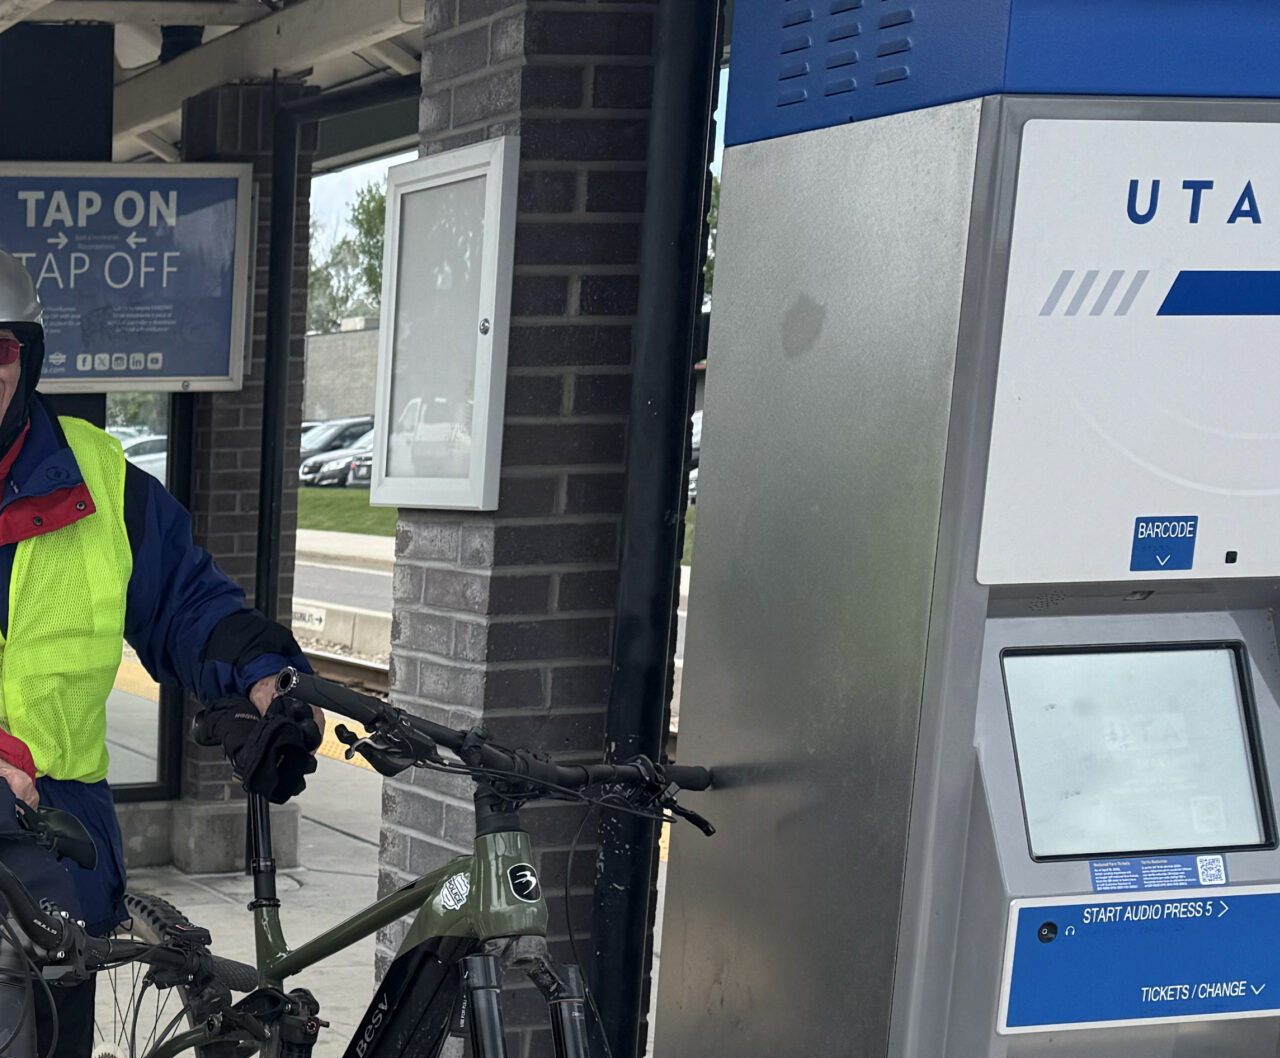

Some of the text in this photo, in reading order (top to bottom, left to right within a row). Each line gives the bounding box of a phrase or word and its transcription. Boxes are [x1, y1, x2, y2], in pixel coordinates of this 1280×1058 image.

[18, 190, 178, 228] TAP ON
[1126, 178, 1263, 225] UTA
[104, 251, 181, 289] OFF
[1137, 521, 1195, 539] BARCODE
[447, 880, 463, 905] POLICE
[1082, 900, 1213, 924] START AUDIO PRESS 5
[1140, 984, 1189, 1003] TICKETS
[1198, 980, 1246, 999] CHANGE
